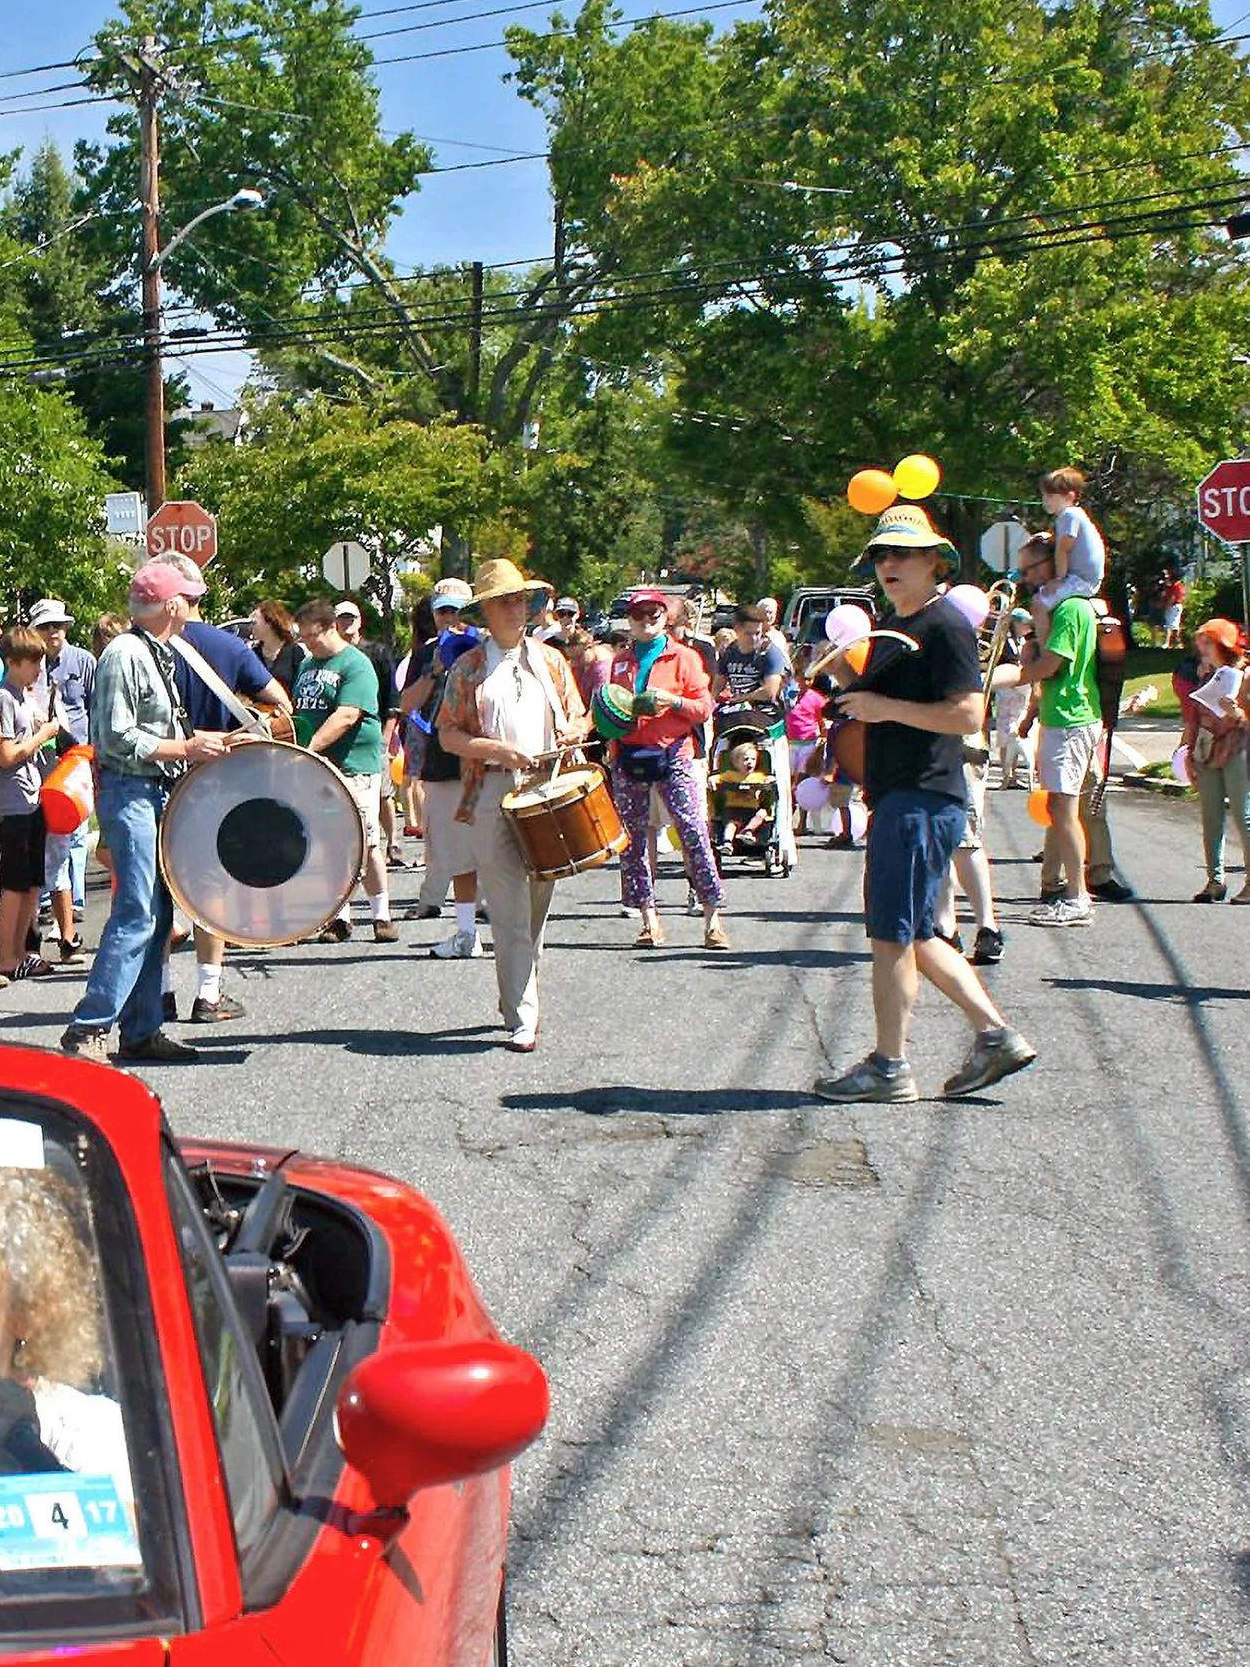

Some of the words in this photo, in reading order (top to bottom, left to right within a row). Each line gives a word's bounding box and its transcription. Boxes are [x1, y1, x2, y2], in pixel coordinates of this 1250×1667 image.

[151, 524, 211, 553] STOP
[51, 1502, 69, 1530] 4
[85, 1500, 117, 1523] 17
